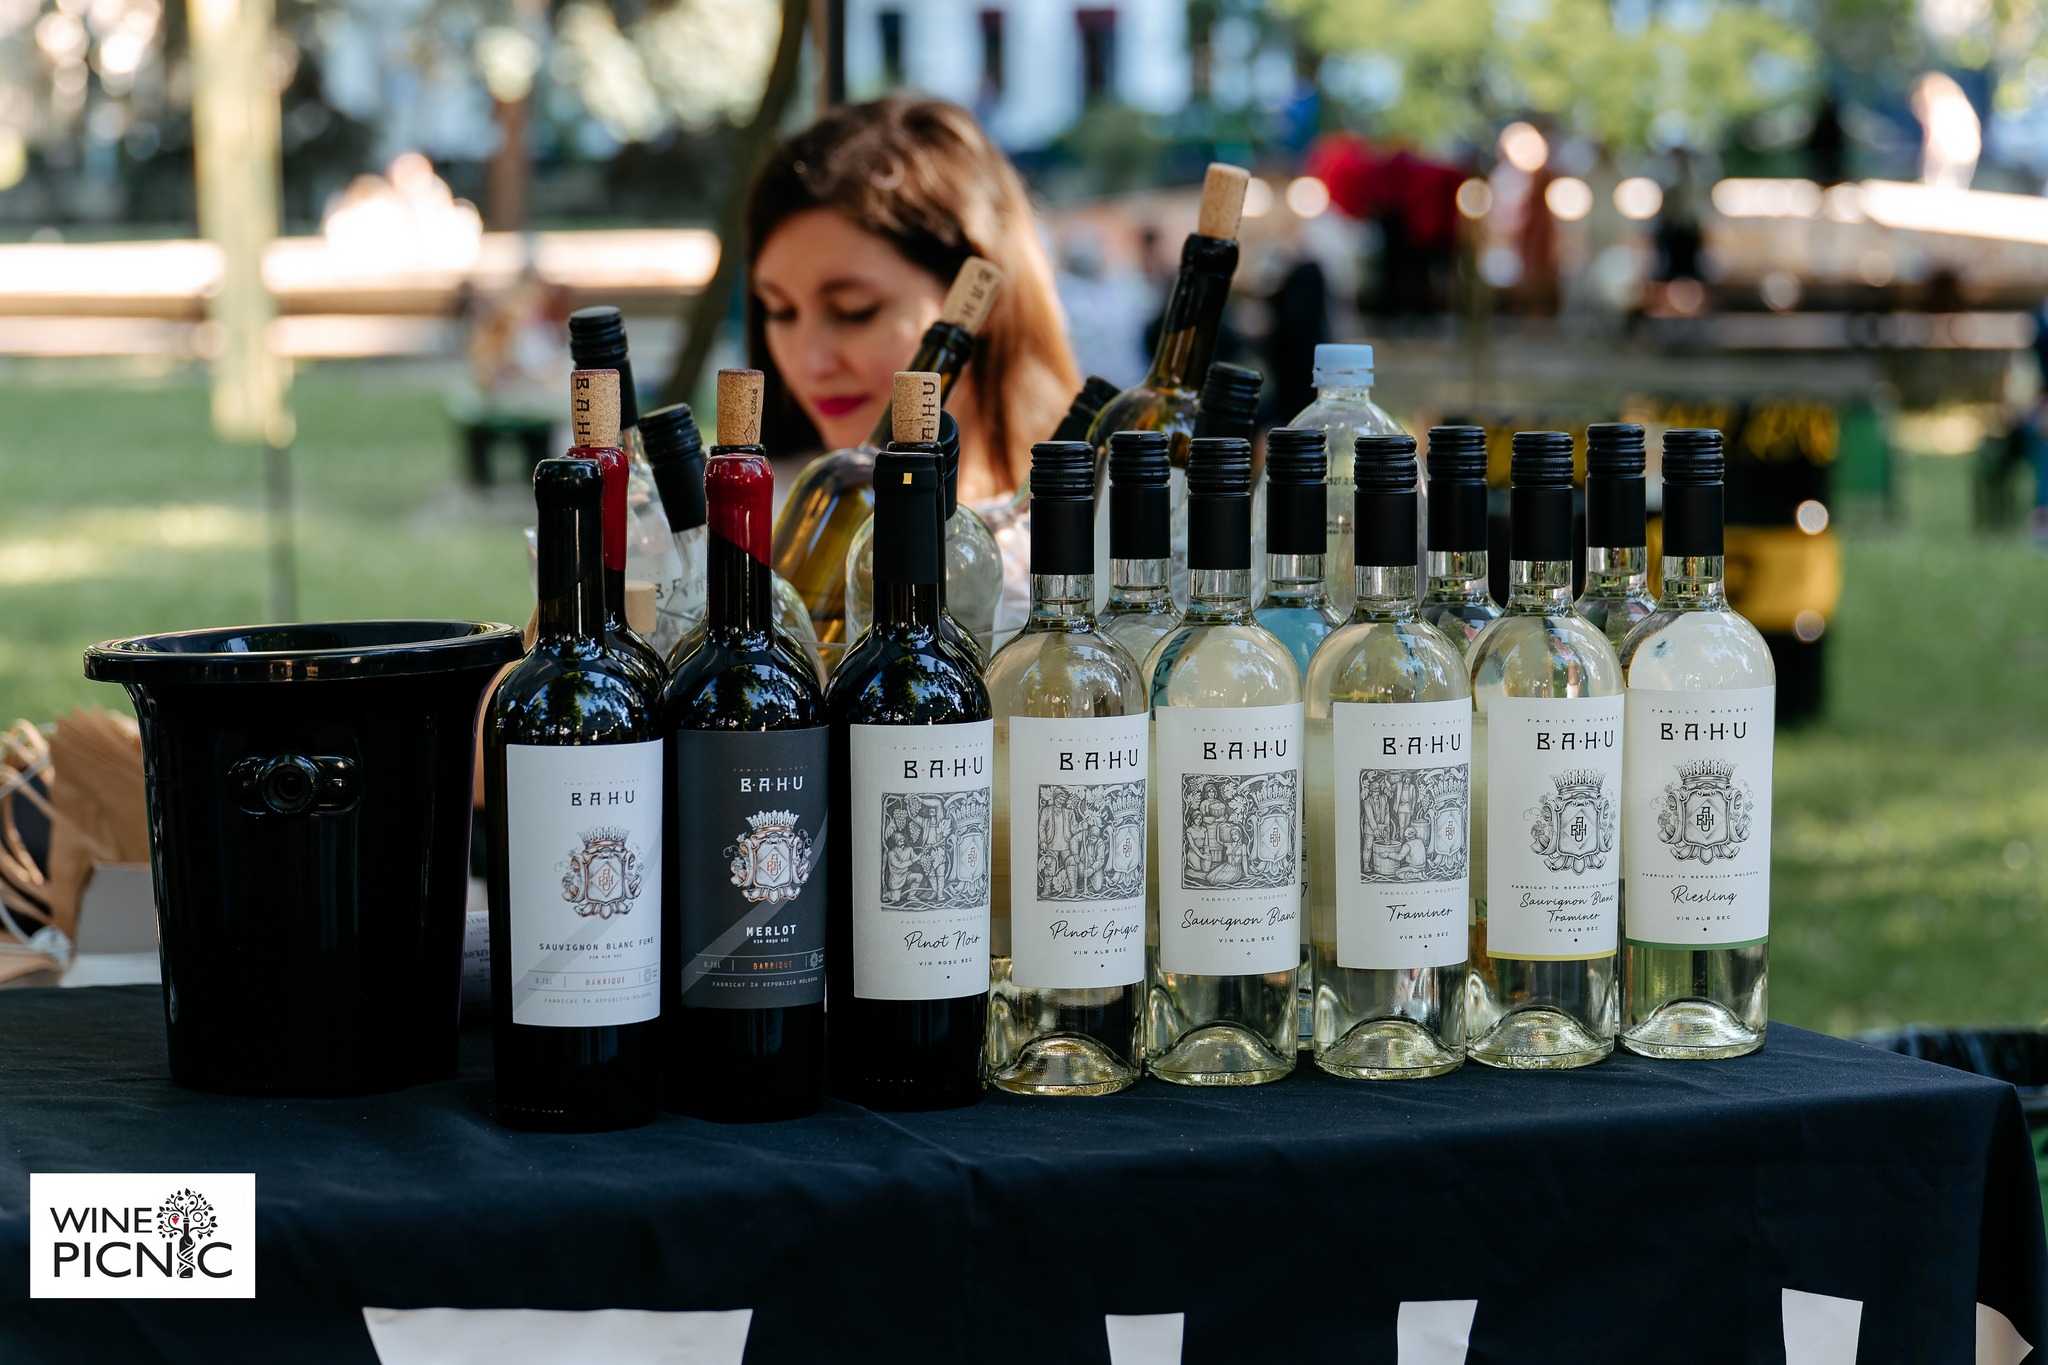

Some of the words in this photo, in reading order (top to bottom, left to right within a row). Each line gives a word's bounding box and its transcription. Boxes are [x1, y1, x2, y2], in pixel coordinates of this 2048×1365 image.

[1519, 892, 1588, 909] Sauvignon
[1590, 890, 1614, 906] Blanc
[1671, 884, 1737, 906] Riesling
[1181, 908, 1263, 931] Sauvignon
[1266, 906, 1297, 926] Blanc
[1386, 904, 1453, 922] Traminer
[1546, 909, 1600, 923] Traminer
[746, 924, 797, 937] MERLOT
[1049, 920, 1098, 939] Pinot
[1102, 920, 1139, 944] Grigio
[539, 943, 599, 951] SAUVIGNON
[606, 940, 634, 950] BLANC
[904, 930, 949, 951] Pinot
[953, 930, 981, 950] Noir
[753, 960, 792, 970] BARRIQUE
[585, 976, 625, 986] BARRIQUE
